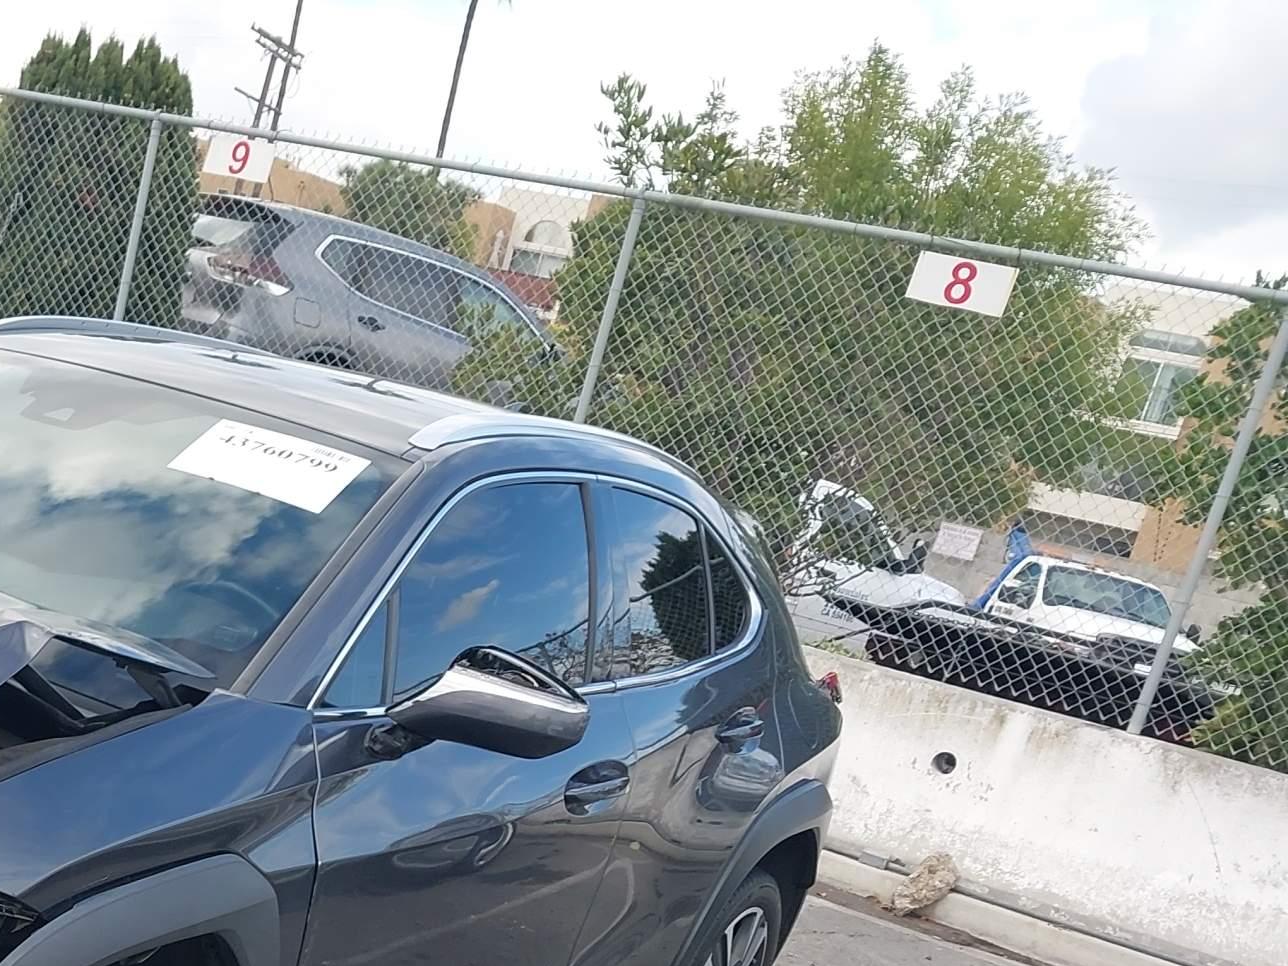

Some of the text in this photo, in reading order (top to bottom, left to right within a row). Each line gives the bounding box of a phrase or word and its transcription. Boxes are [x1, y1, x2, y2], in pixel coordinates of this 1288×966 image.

[228, 141, 250, 174] 9
[944, 261, 977, 305] 8
[219, 434, 339, 473] 43760799
